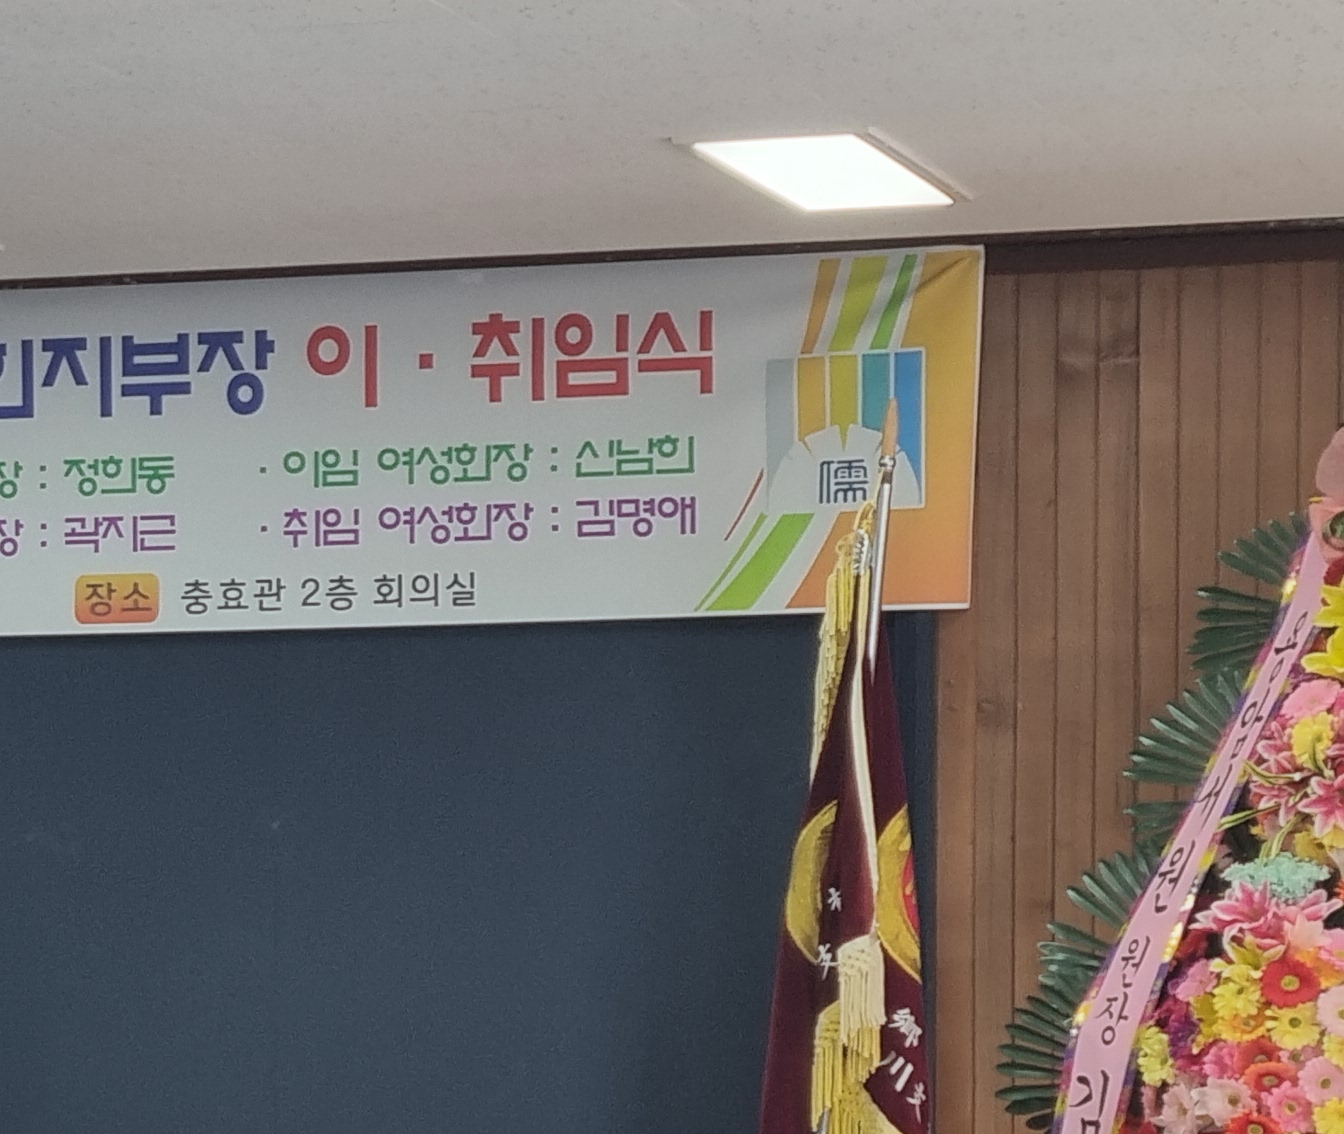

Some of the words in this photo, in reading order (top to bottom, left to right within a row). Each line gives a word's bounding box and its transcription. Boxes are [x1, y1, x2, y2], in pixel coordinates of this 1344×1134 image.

[307, 325, 377, 407] 이
[471, 310, 713, 402] 취임식
[63, 456, 175, 496] 정희동
[284, 450, 358, 488] 이임
[378, 443, 533, 484] 여성회장
[576, 435, 694, 477] 신남희
[819, 459, 868, 504] 儒
[64, 515, 176, 553] 곽지근
[283, 509, 359, 548] 취임
[379, 503, 534, 544] 여성회장
[576, 496, 696, 537] 김명애
[84, 582, 152, 616] 장소
[181, 578, 286, 614] 충효관
[301, 575, 357, 610] 2층
[374, 572, 475, 607] 회의실
[1096, 936, 1150, 1046] 원장
